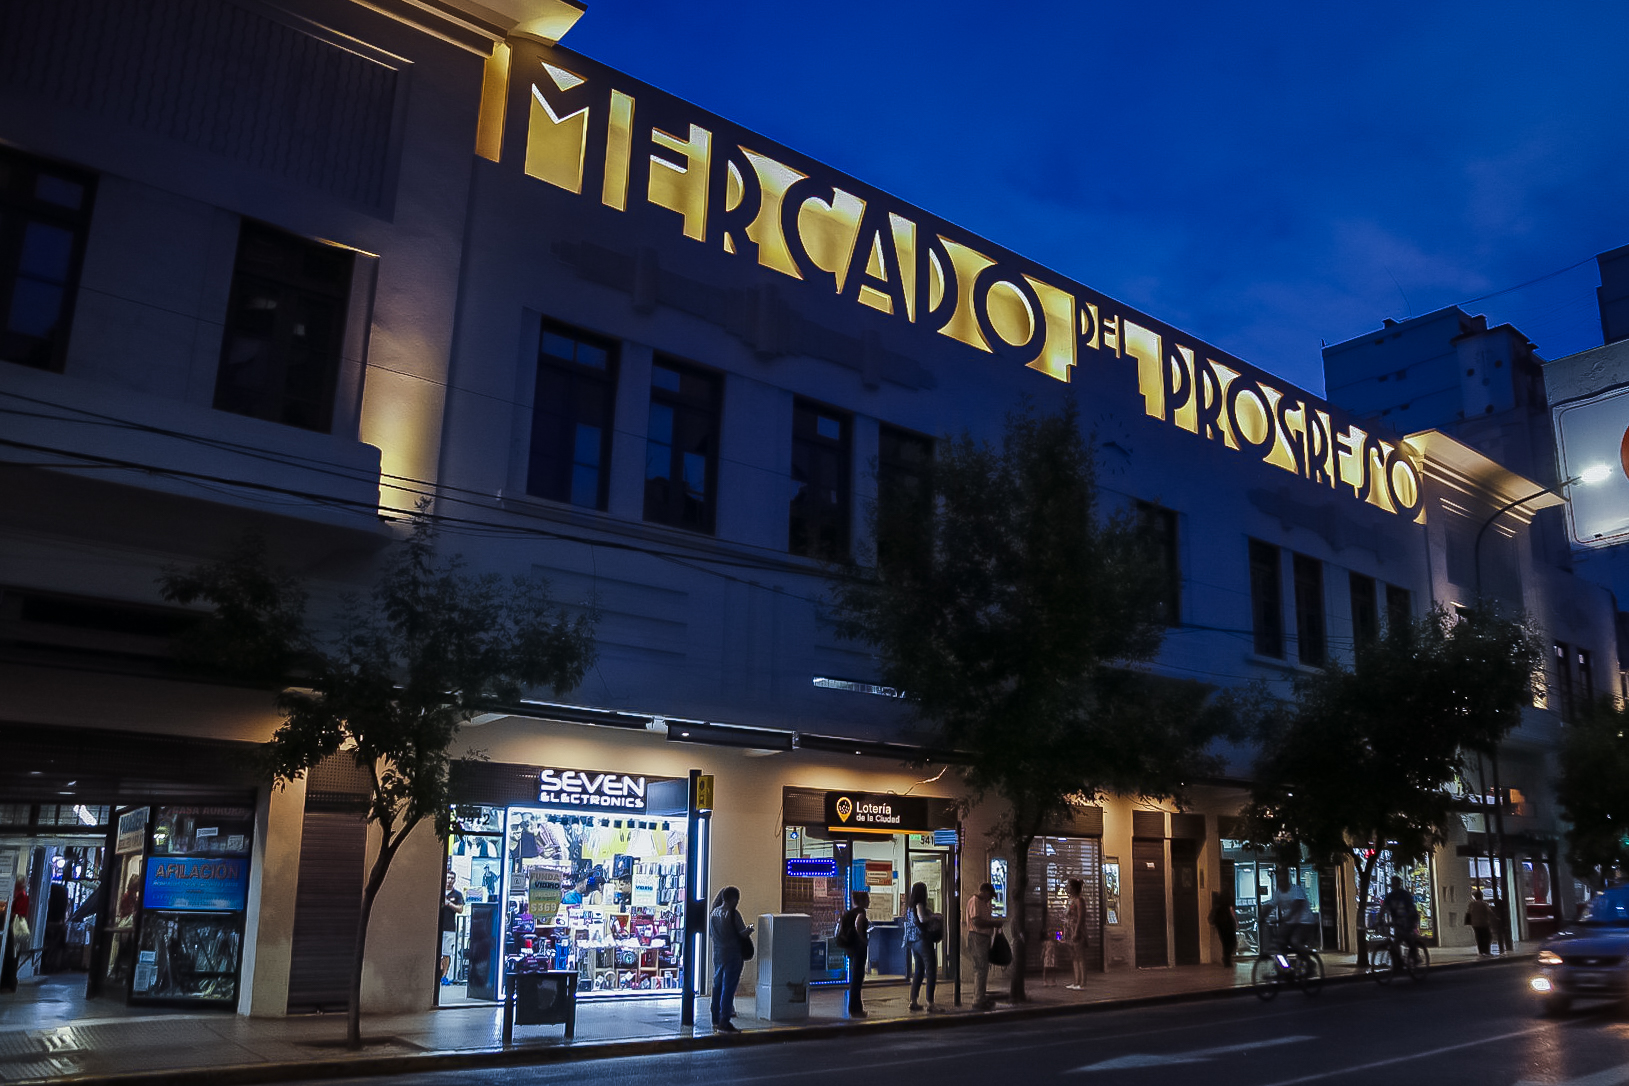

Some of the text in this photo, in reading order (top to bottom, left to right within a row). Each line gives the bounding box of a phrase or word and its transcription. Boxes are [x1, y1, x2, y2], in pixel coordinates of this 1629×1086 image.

[508, 57, 1060, 374] MERCADO
[1165, 338, 1423, 520] PROGRESO
[540, 769, 645, 797] SEVEN
[540, 792, 645, 808] ELECTRONICS
[856, 801, 892, 815] Lotería
[856, 813, 900, 824] de la Ciudad
[920, 835, 934, 845] 541
